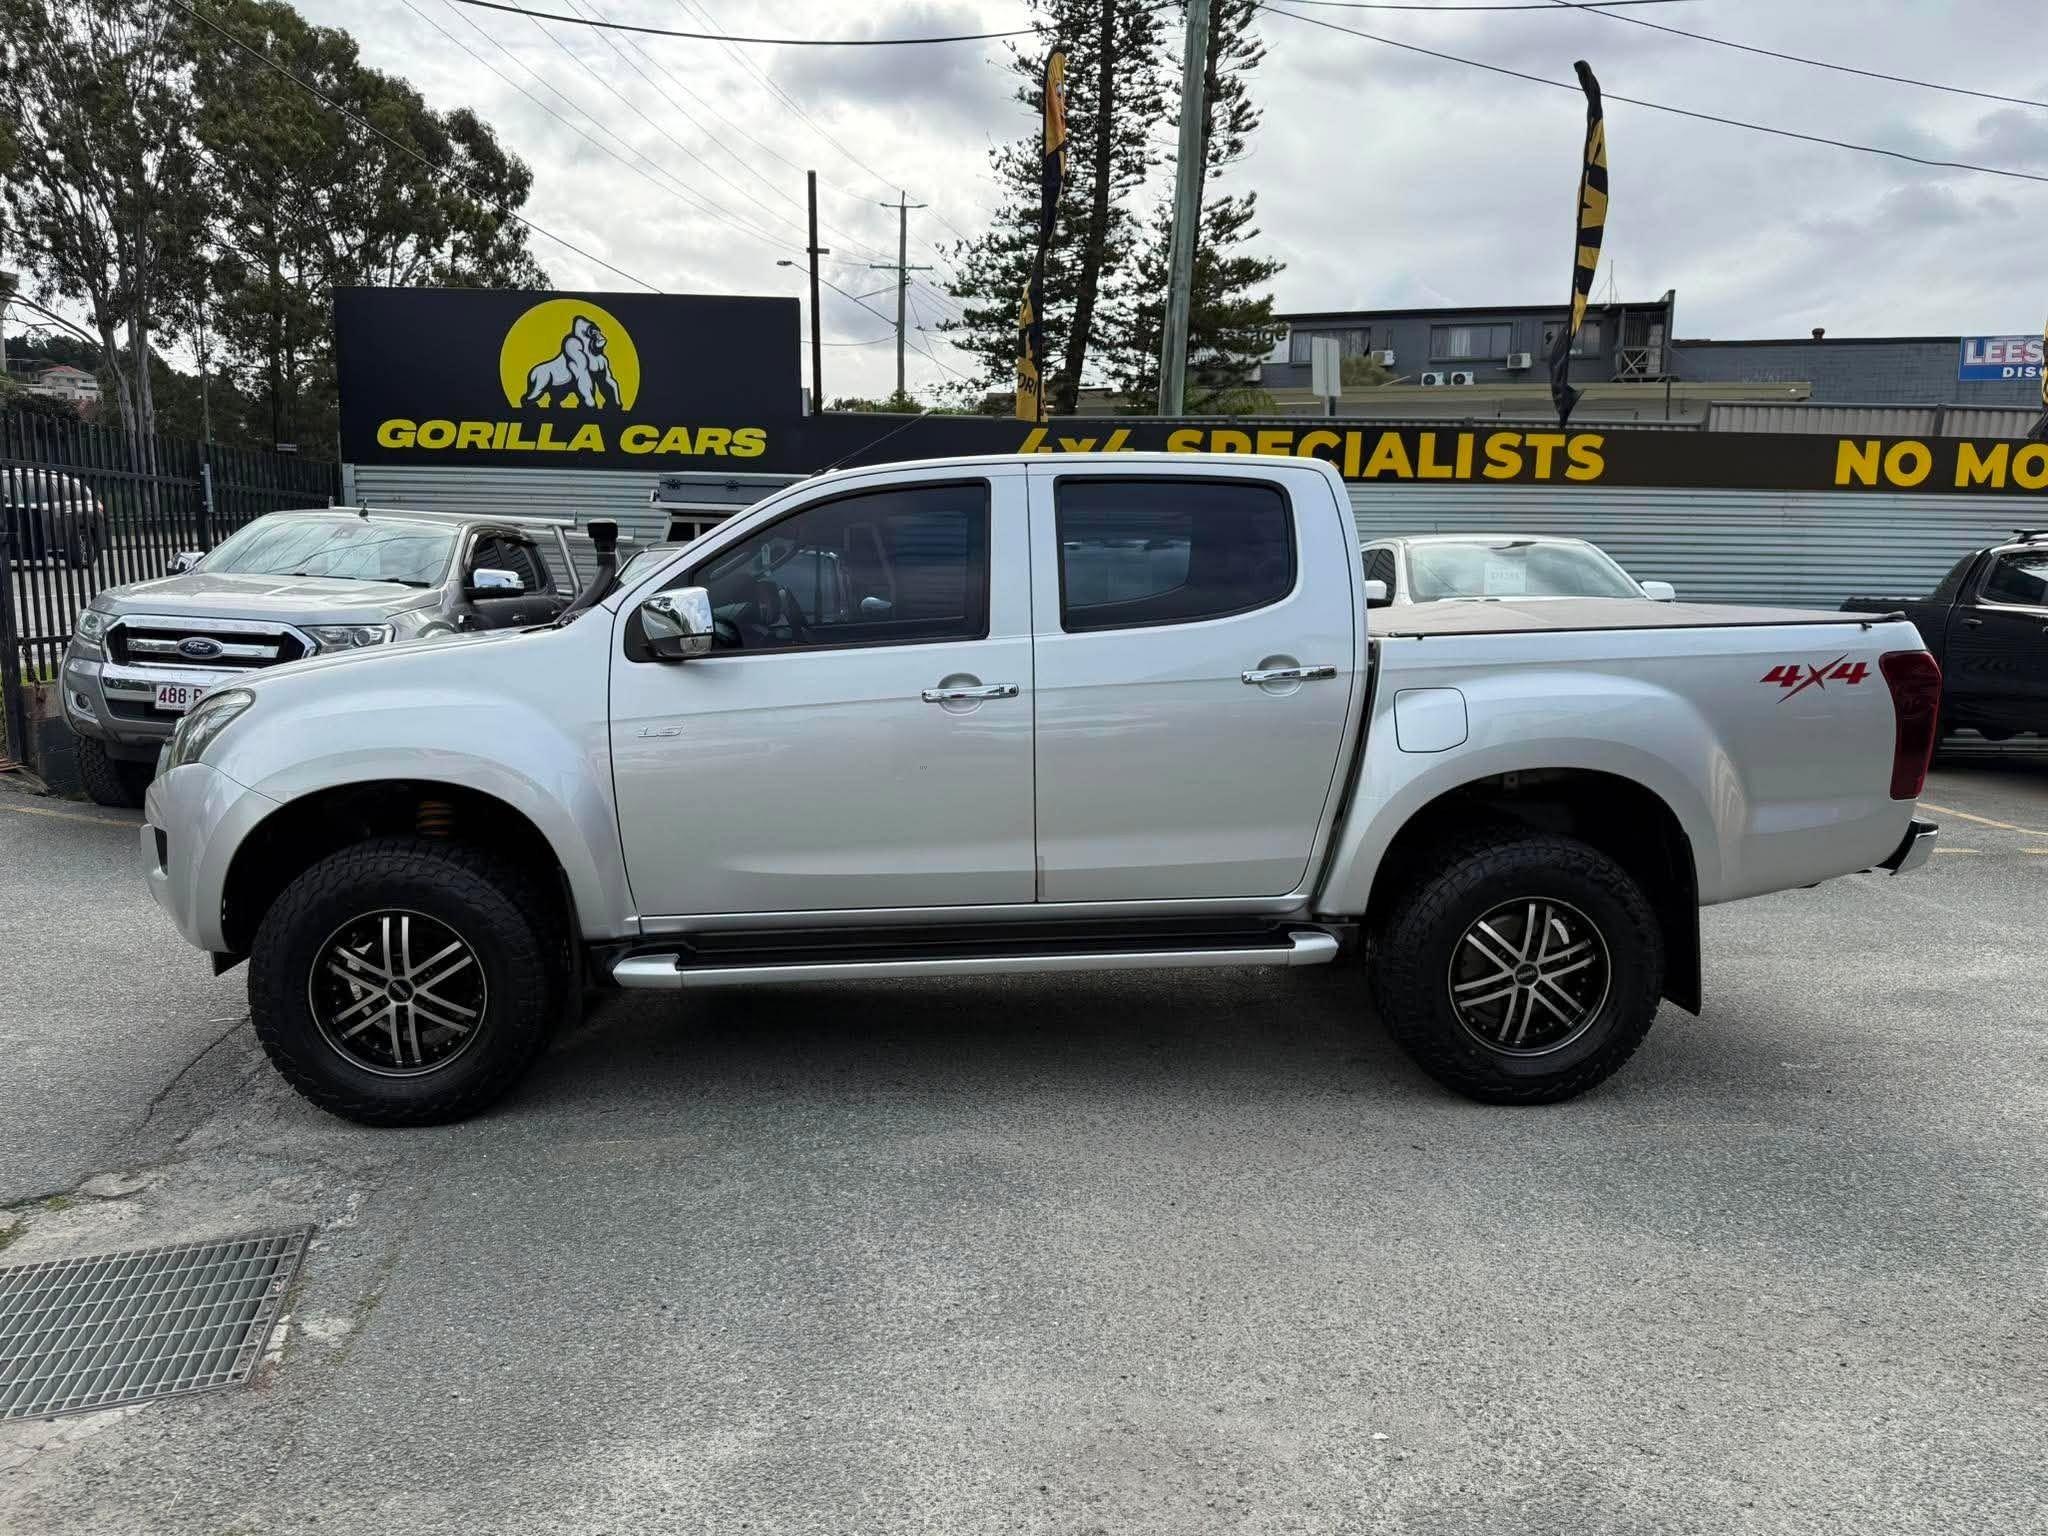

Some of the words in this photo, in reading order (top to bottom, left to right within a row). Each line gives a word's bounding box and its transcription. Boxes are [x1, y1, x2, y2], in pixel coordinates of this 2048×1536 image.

[2002, 366, 2043, 379] DIS
[376, 419, 606, 452] GORILLA
[619, 424, 767, 457] CARS
[1835, 440, 1932, 487] NO
